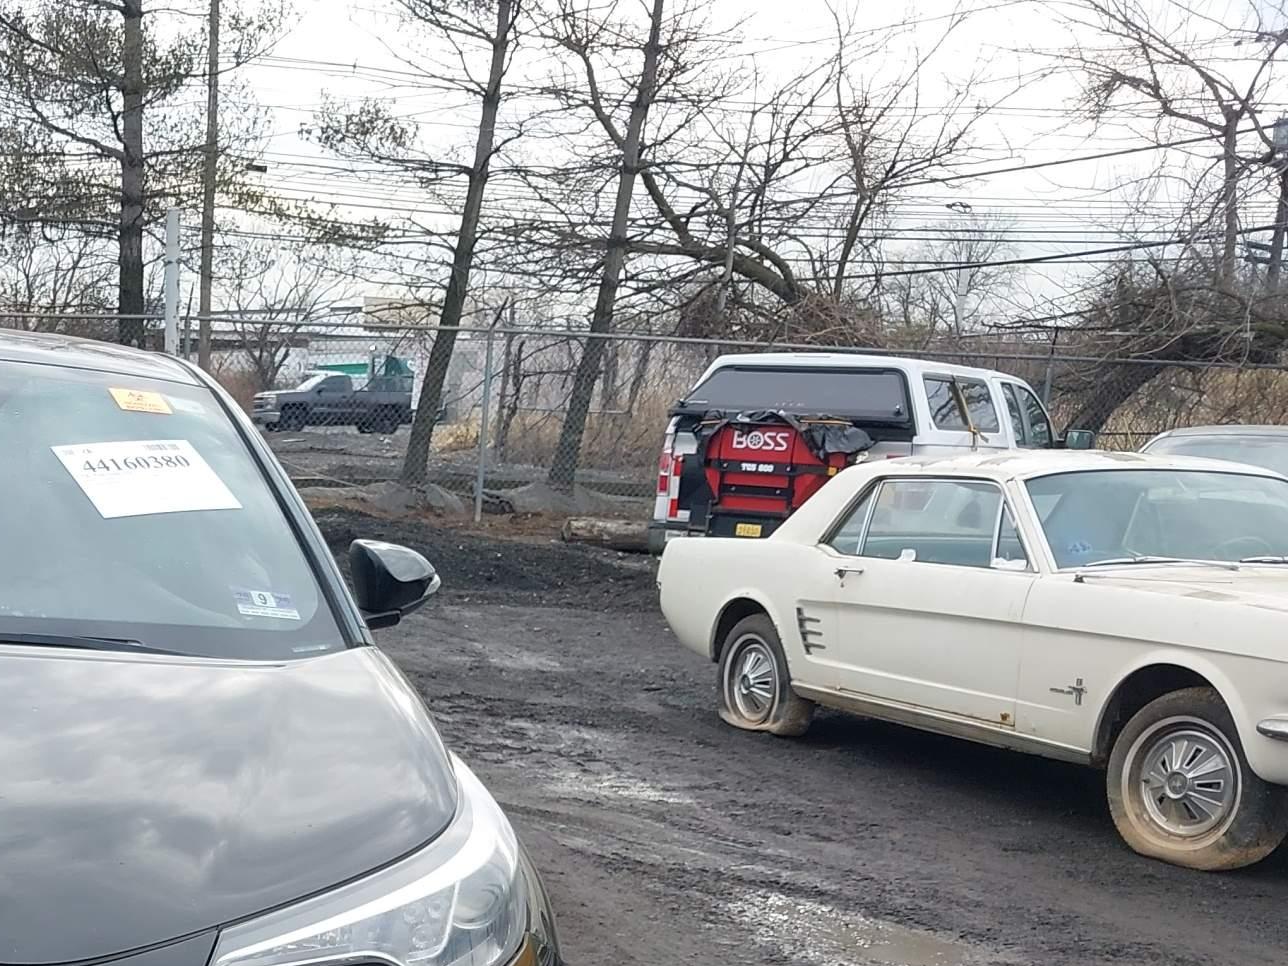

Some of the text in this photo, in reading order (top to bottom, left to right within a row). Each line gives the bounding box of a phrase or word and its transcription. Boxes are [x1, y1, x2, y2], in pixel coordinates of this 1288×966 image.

[732, 430, 790, 451] BOSS
[83, 455, 191, 473] 44160380
[257, 593, 268, 605] 9
